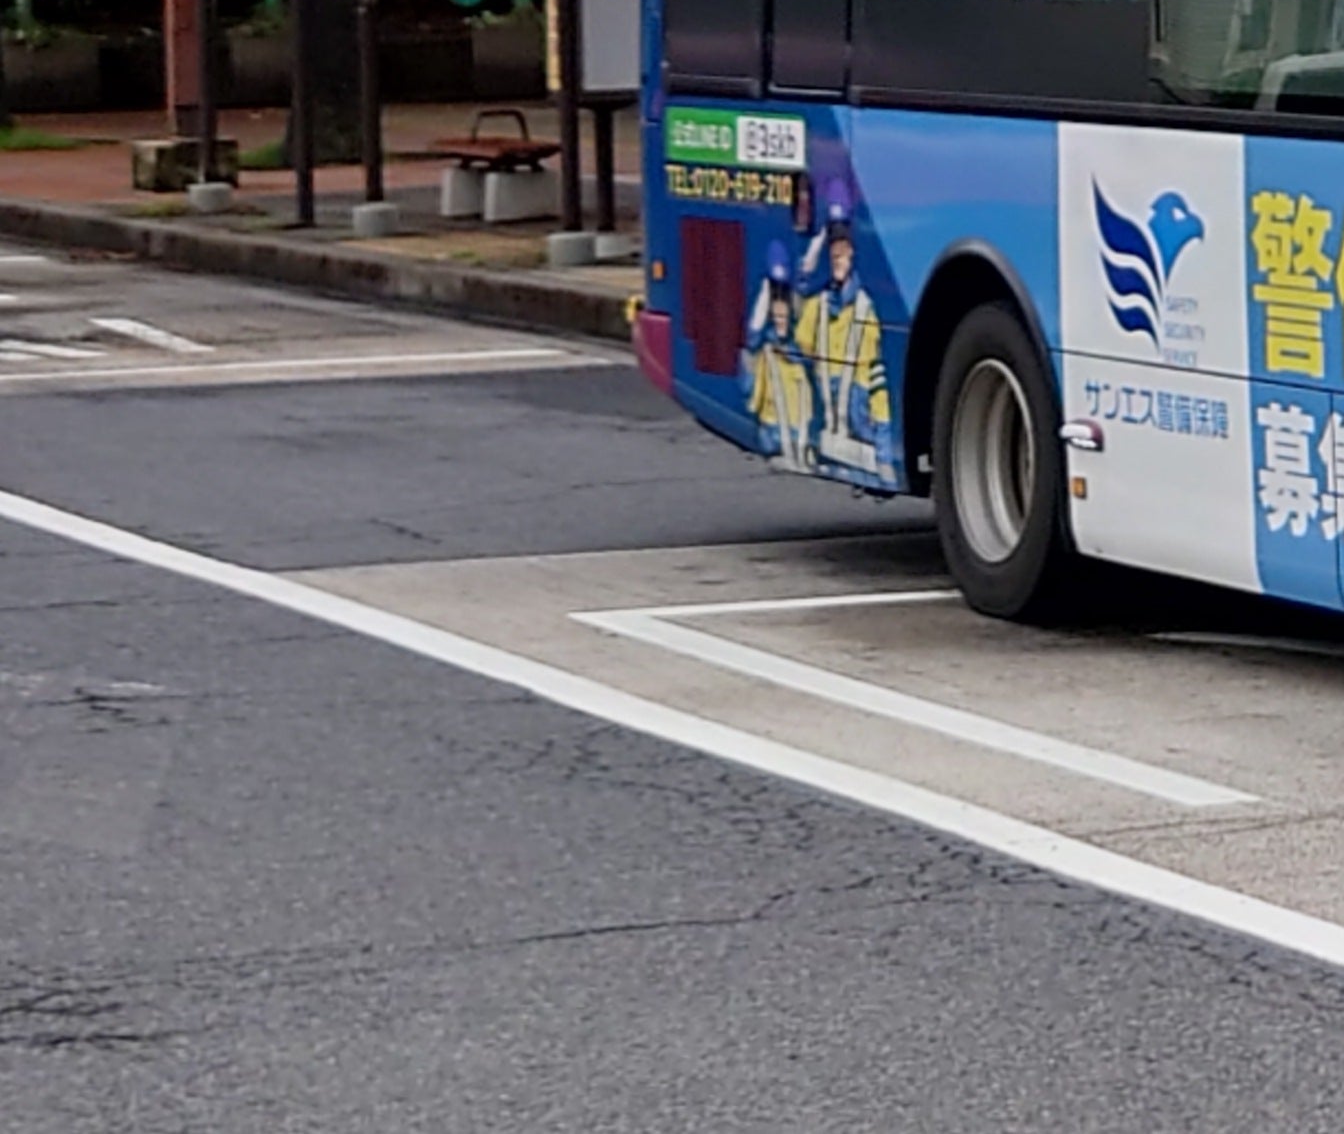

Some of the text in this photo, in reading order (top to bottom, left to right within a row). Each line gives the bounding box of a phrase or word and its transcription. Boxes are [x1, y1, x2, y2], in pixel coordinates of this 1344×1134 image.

[1084, 378, 1229, 440] サンエス警備保障
